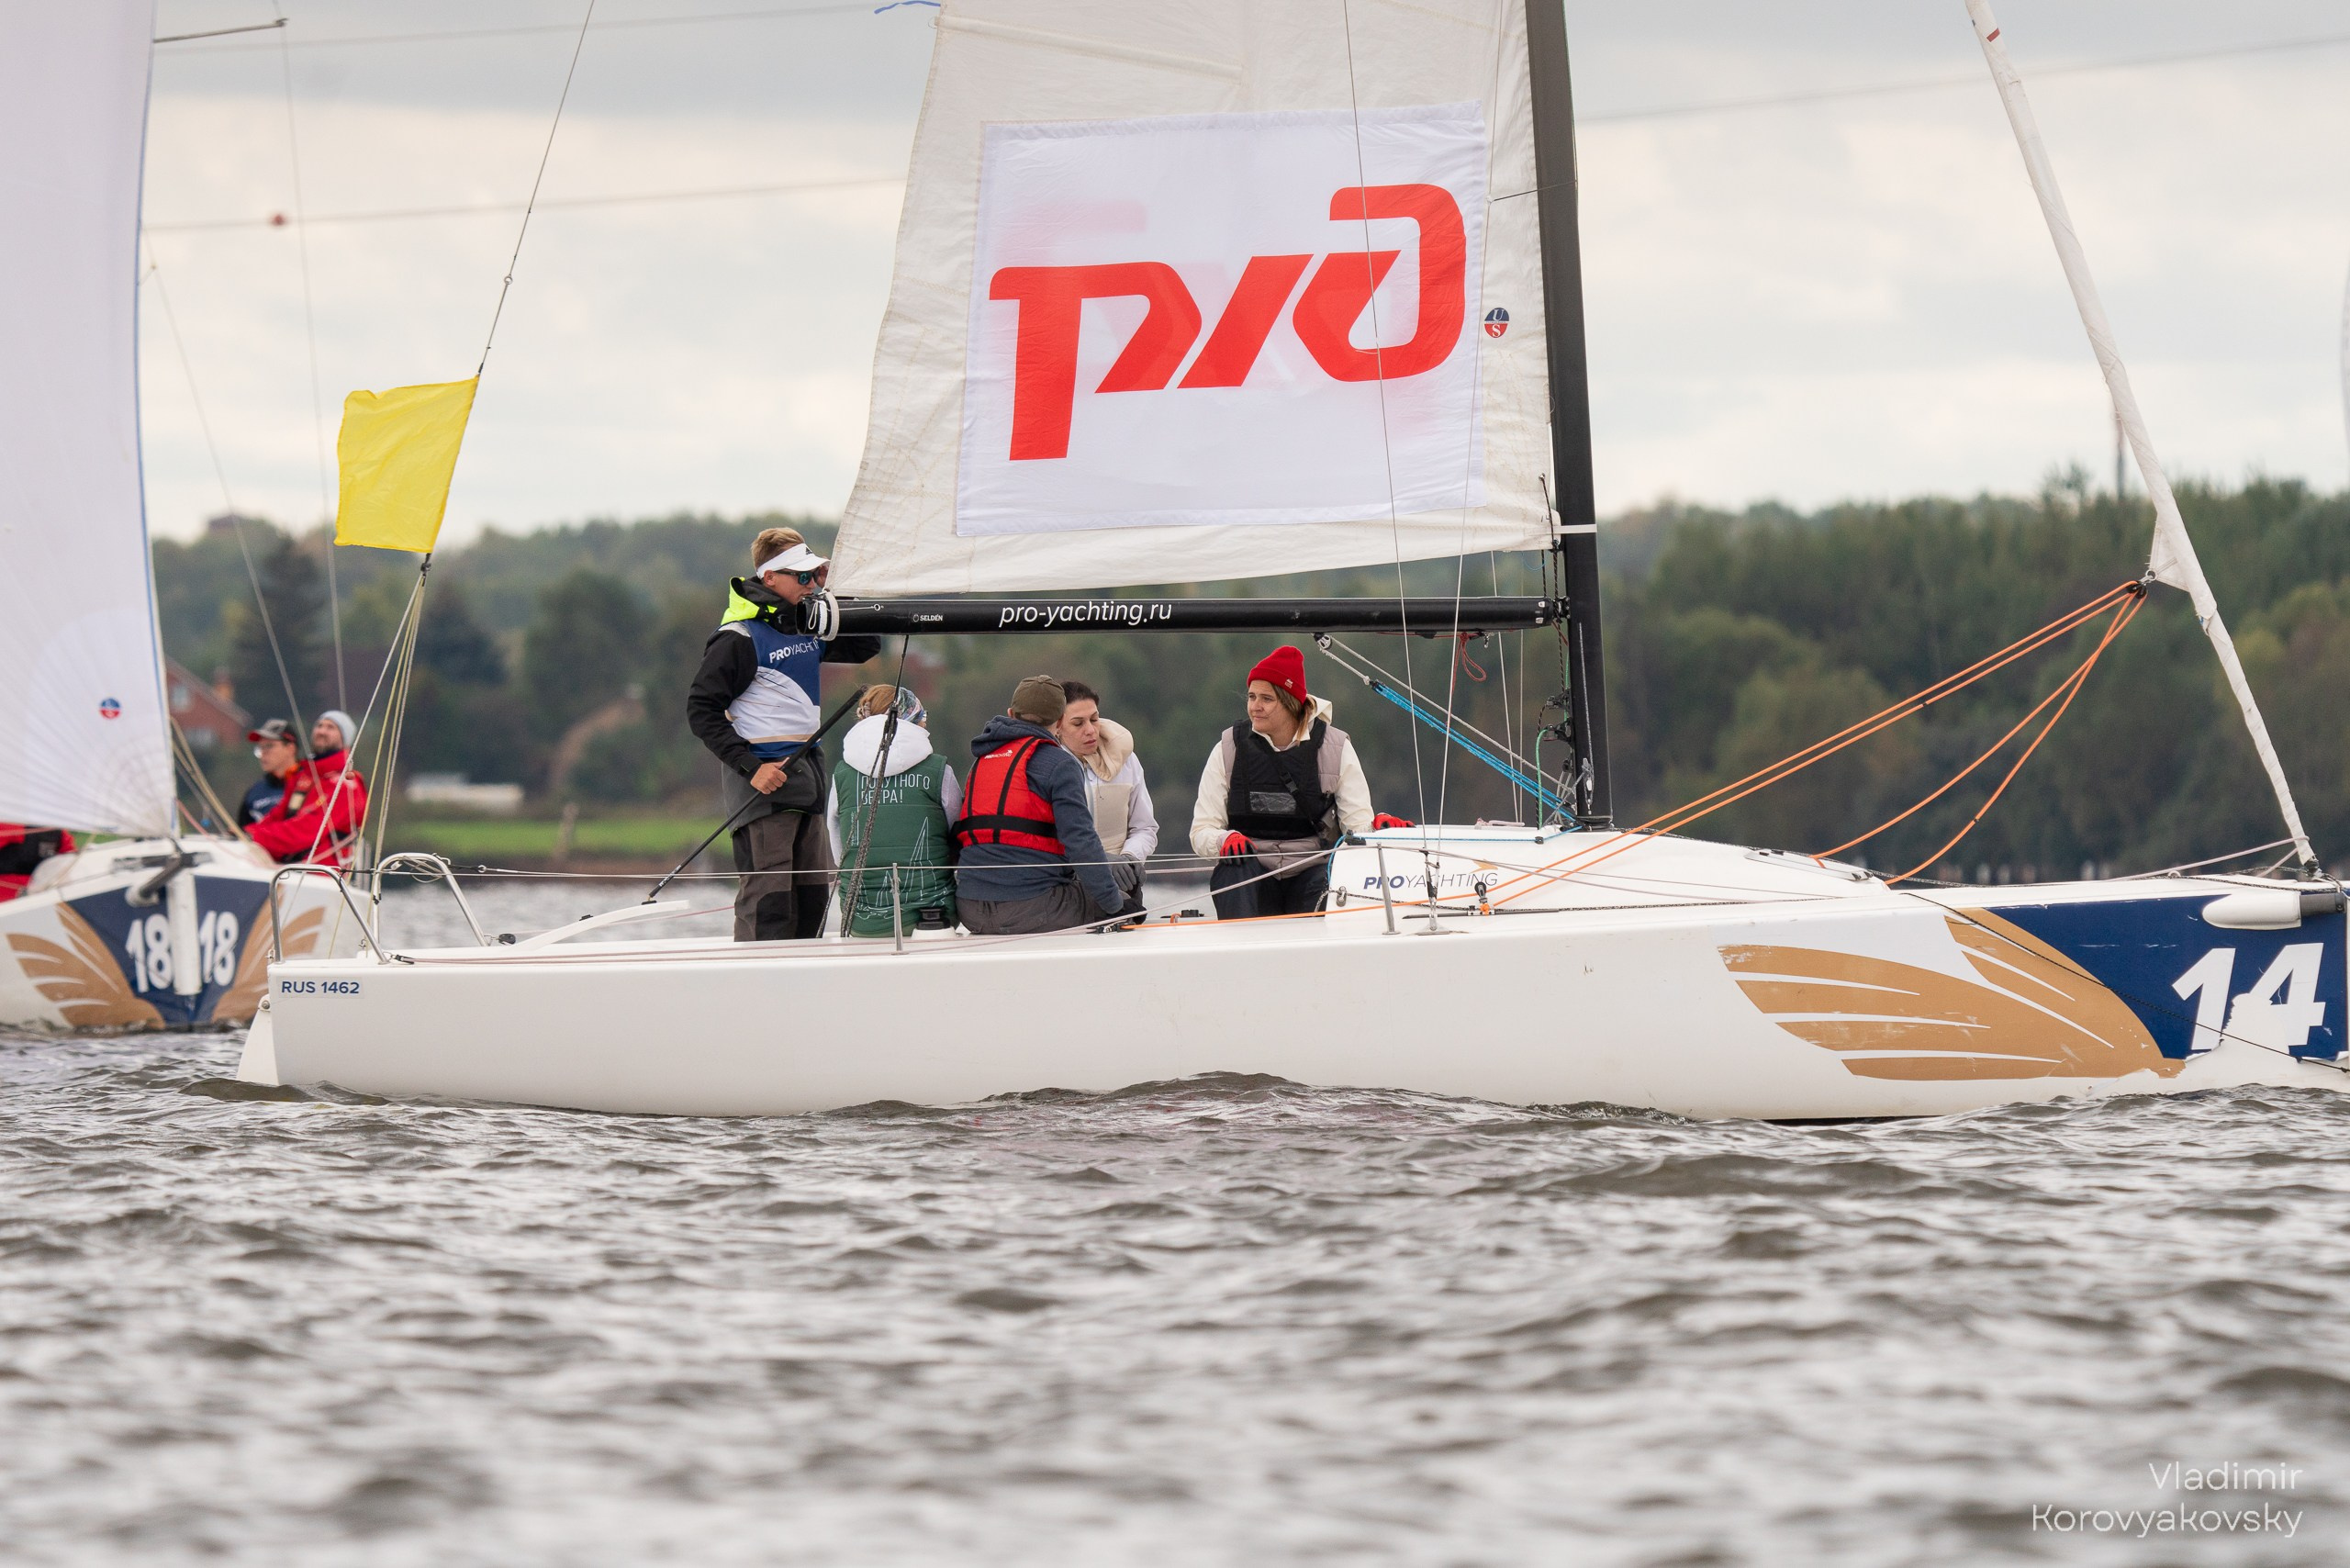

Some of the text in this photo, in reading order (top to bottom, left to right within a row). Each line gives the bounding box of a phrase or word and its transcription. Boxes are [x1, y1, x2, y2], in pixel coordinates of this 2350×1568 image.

[998, 600, 1172, 628] pro-yachting.ru
[861, 773, 931, 790] ПОУТНОГО
[861, 789, 903, 805] ВЕРА!
[1363, 872, 1498, 890] POYAHTING
[125, 913, 173, 992] 18
[199, 910, 239, 987] 18
[281, 980, 360, 994] RUS 1462
[2171, 942, 2327, 1051] 14
